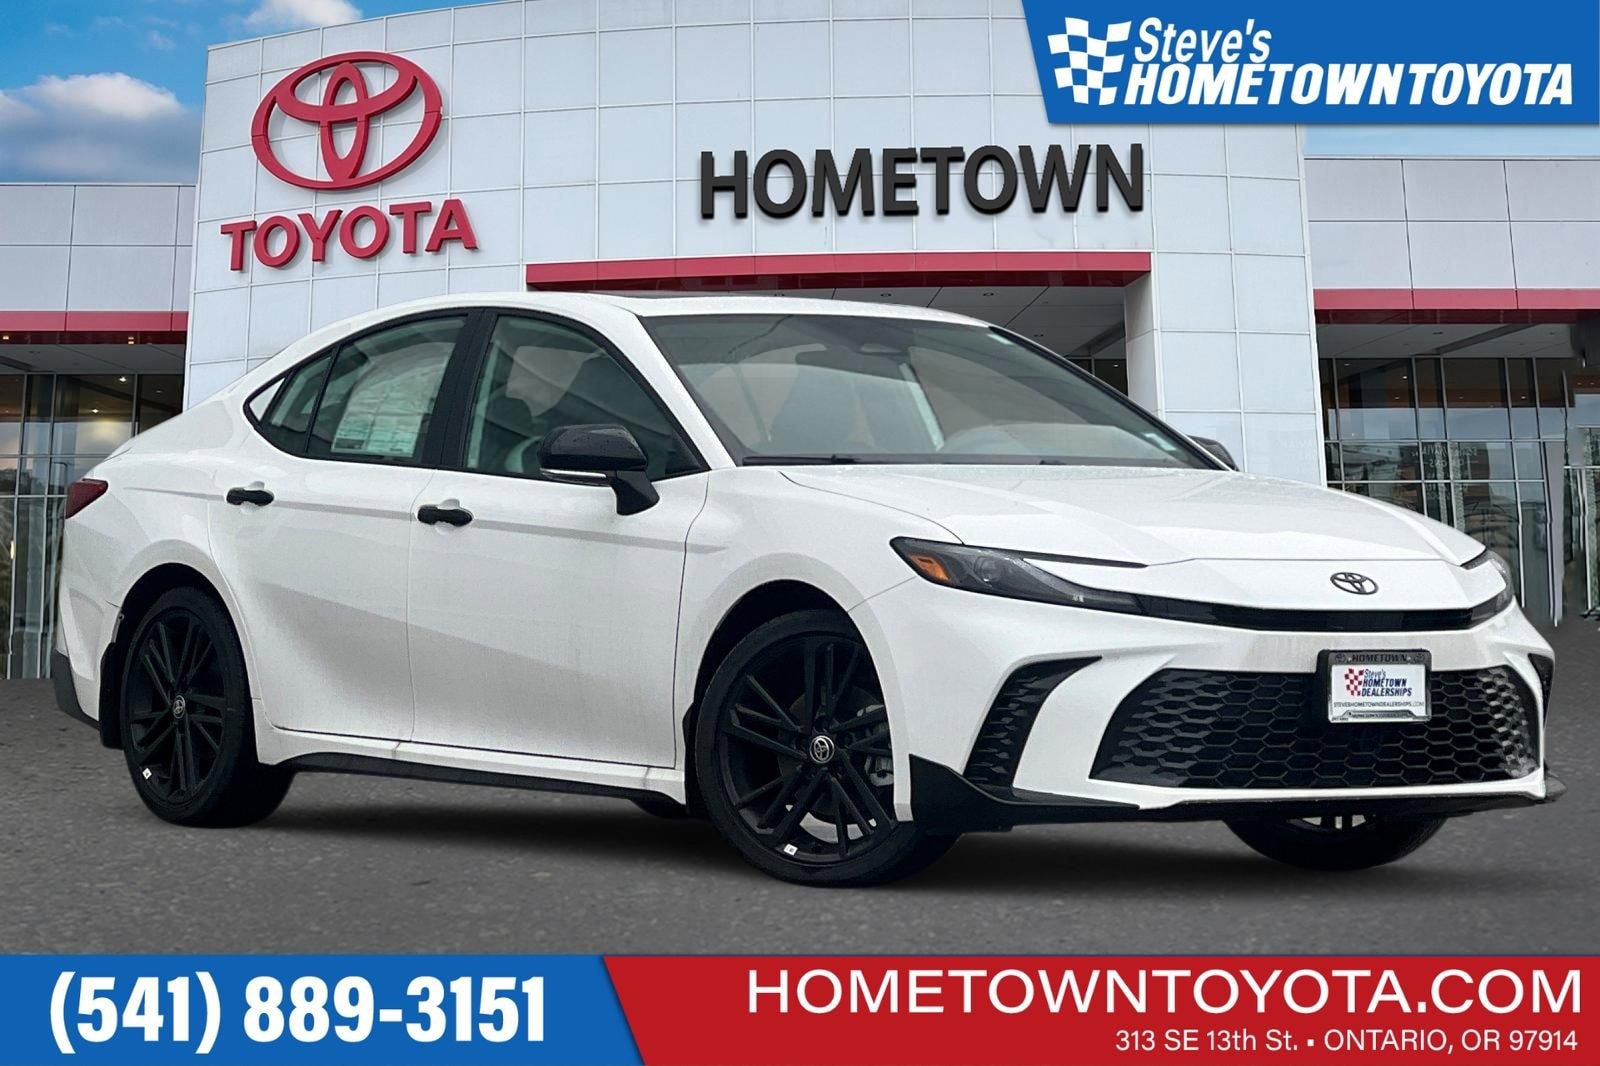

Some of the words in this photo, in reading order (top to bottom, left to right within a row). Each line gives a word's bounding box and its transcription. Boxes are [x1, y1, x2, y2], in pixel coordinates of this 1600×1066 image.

[700, 143, 1144, 219] HOMETOWN
[220, 198, 478, 271] TOYOTA
[1352, 654, 1407, 662] HOMETOWN
[1364, 669, 1386, 678] Steve's
[1363, 679, 1407, 687] HOMETOWN
[1361, 688, 1412, 696] DEALERSHIPS
